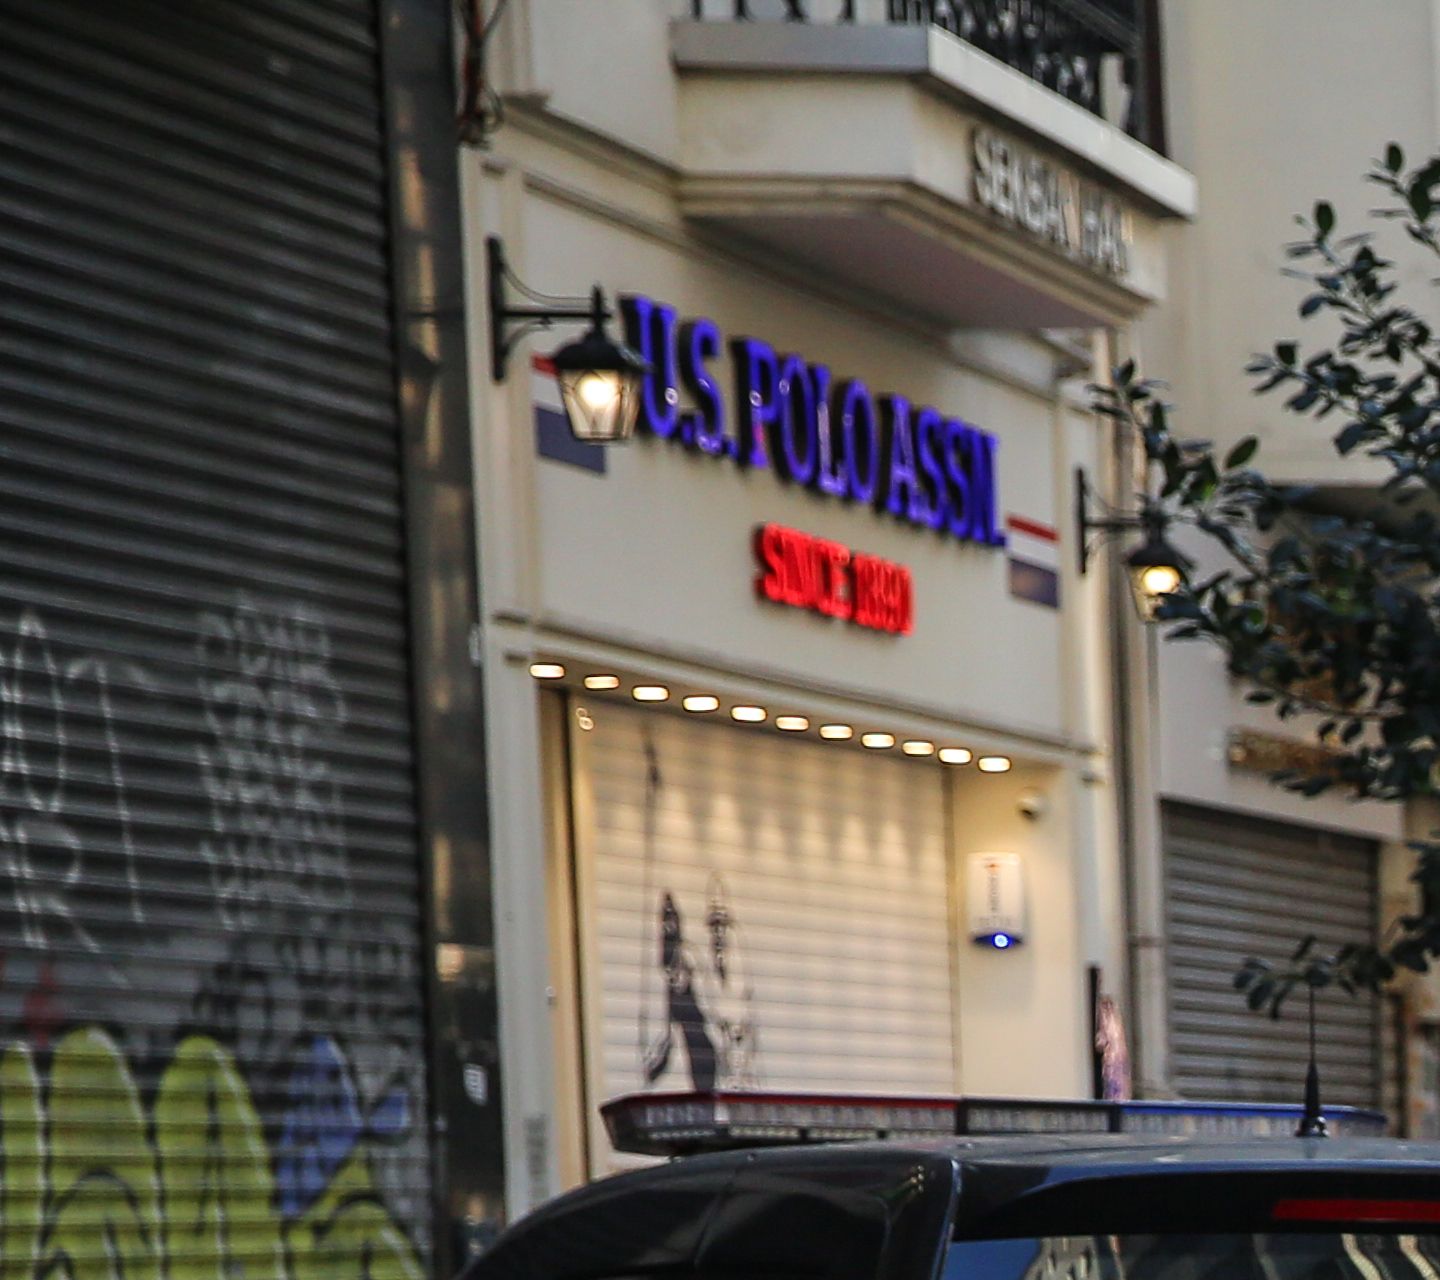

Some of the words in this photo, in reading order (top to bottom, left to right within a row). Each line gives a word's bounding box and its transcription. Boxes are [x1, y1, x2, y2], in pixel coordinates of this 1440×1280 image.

[622, 294, 740, 462] U.S.
[733, 336, 879, 505] POLO
[872, 393, 1006, 548] ASSN.
[753, 521, 850, 622] SINCE
